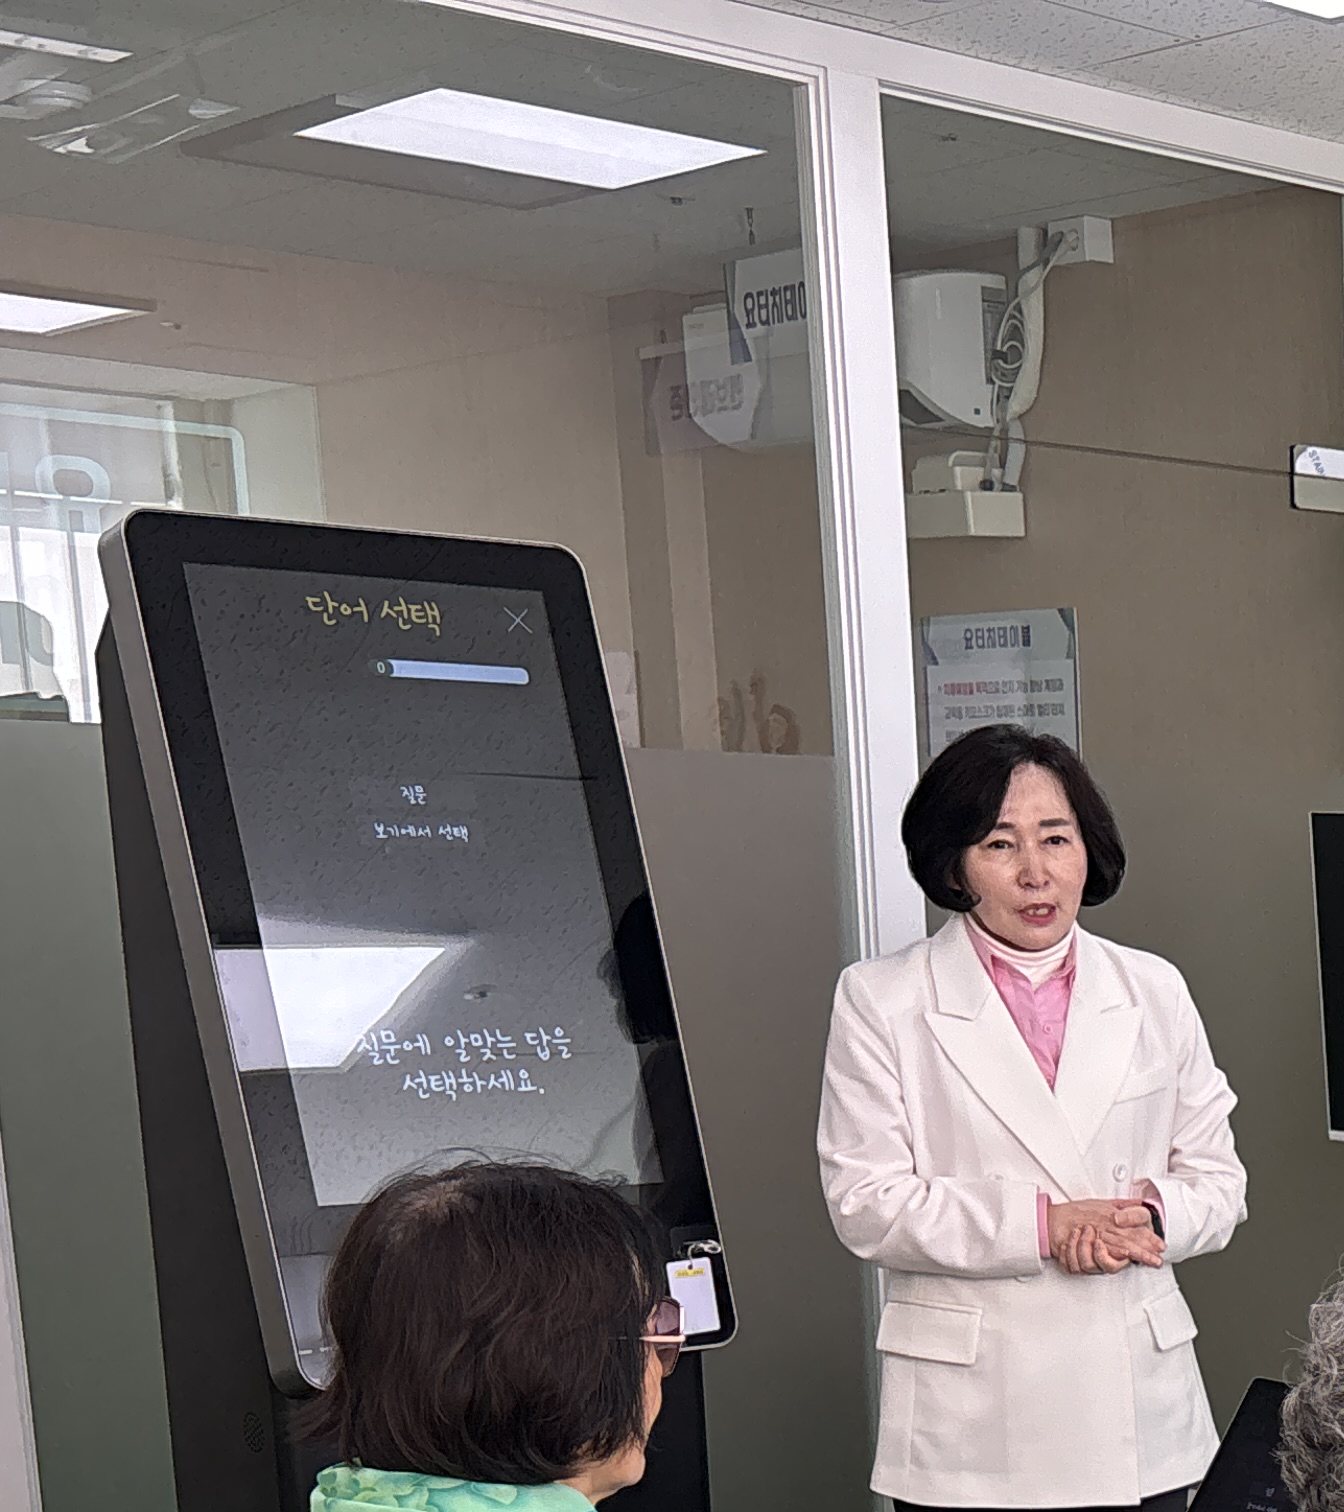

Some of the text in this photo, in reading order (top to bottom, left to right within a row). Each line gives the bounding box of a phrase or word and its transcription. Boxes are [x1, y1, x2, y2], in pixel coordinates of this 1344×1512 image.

[304, 591, 442, 637] 단어 선택
[400, 784, 428, 805] 질문
[373, 822, 470, 843] 보기에서 선택
[443, 1027, 517, 1063] 알맞는
[524, 1027, 573, 1061] 답을
[402, 1070, 545, 1100] 선택하세요.
